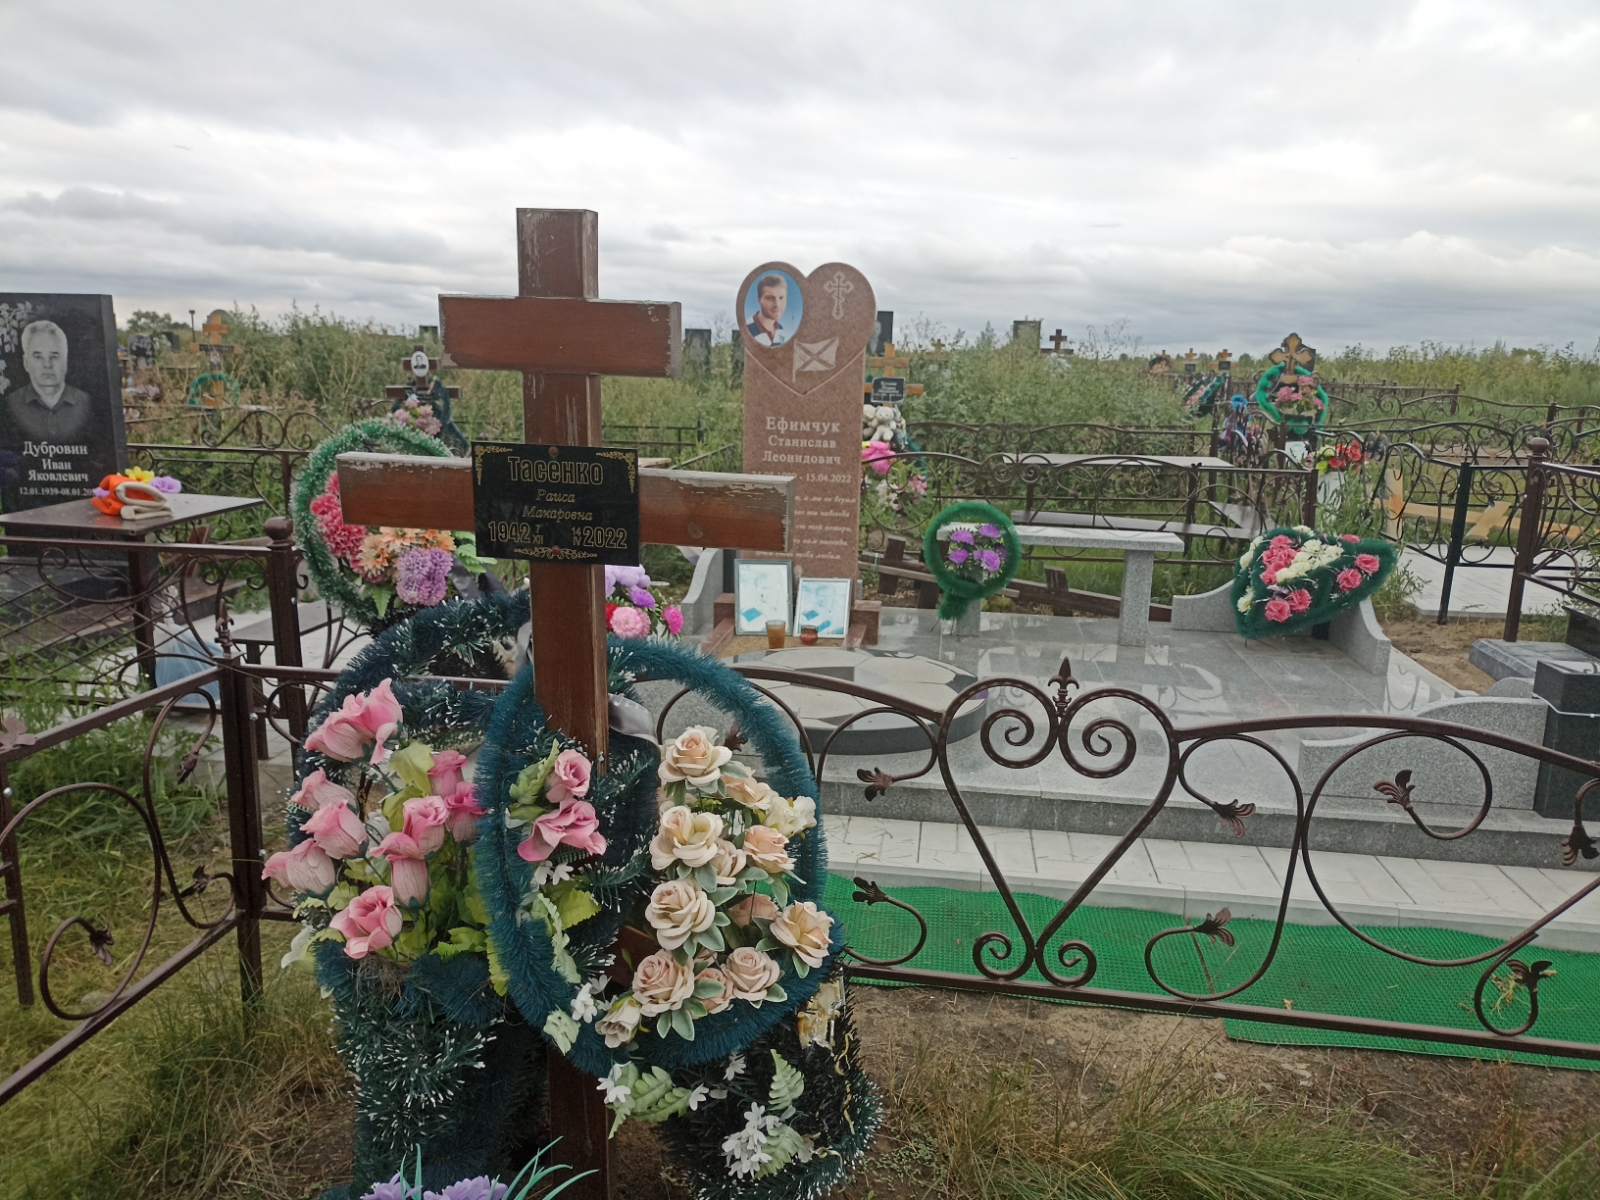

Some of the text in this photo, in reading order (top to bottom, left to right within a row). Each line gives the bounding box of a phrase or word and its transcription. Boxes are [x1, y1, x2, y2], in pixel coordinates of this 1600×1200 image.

[765, 416, 840, 435] Ефимчук
[23, 441, 88, 457] Дубровин
[768, 435, 836, 448] Станислав
[41, 459, 72, 470] Иван
[763, 451, 841, 465] Леонидович
[28, 469, 89, 482] Яковлевич
[508, 456, 604, 485] Тасенко
[806, 473, 852, 483] 15.04.2022
[535, 489, 576, 503] Раиса
[522, 506, 593, 523] Макаровна
[488, 521, 531, 543] 1942
[583, 526, 628, 549] 2022
